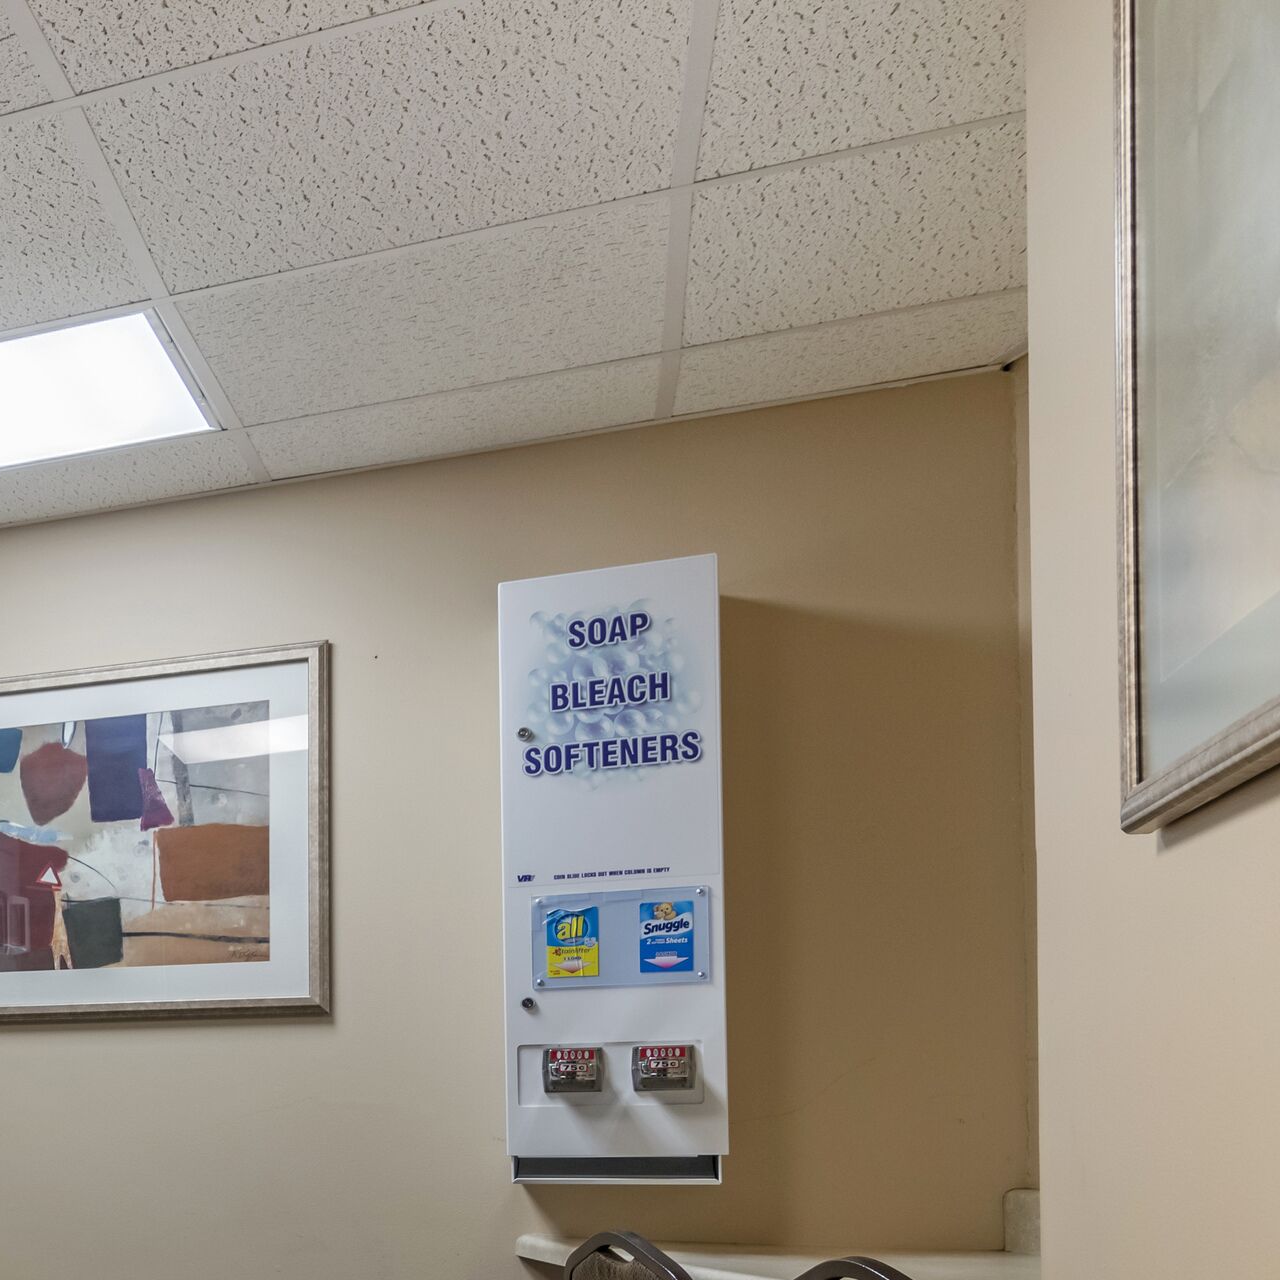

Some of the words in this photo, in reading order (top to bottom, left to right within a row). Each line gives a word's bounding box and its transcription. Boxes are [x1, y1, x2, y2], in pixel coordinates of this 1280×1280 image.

[568, 613, 649, 648] SOAP
[550, 671, 669, 711] BLEACH
[523, 731, 700, 775] SOFTENERS
[557, 915, 584, 940] all
[643, 918, 690, 935] Snuggle
